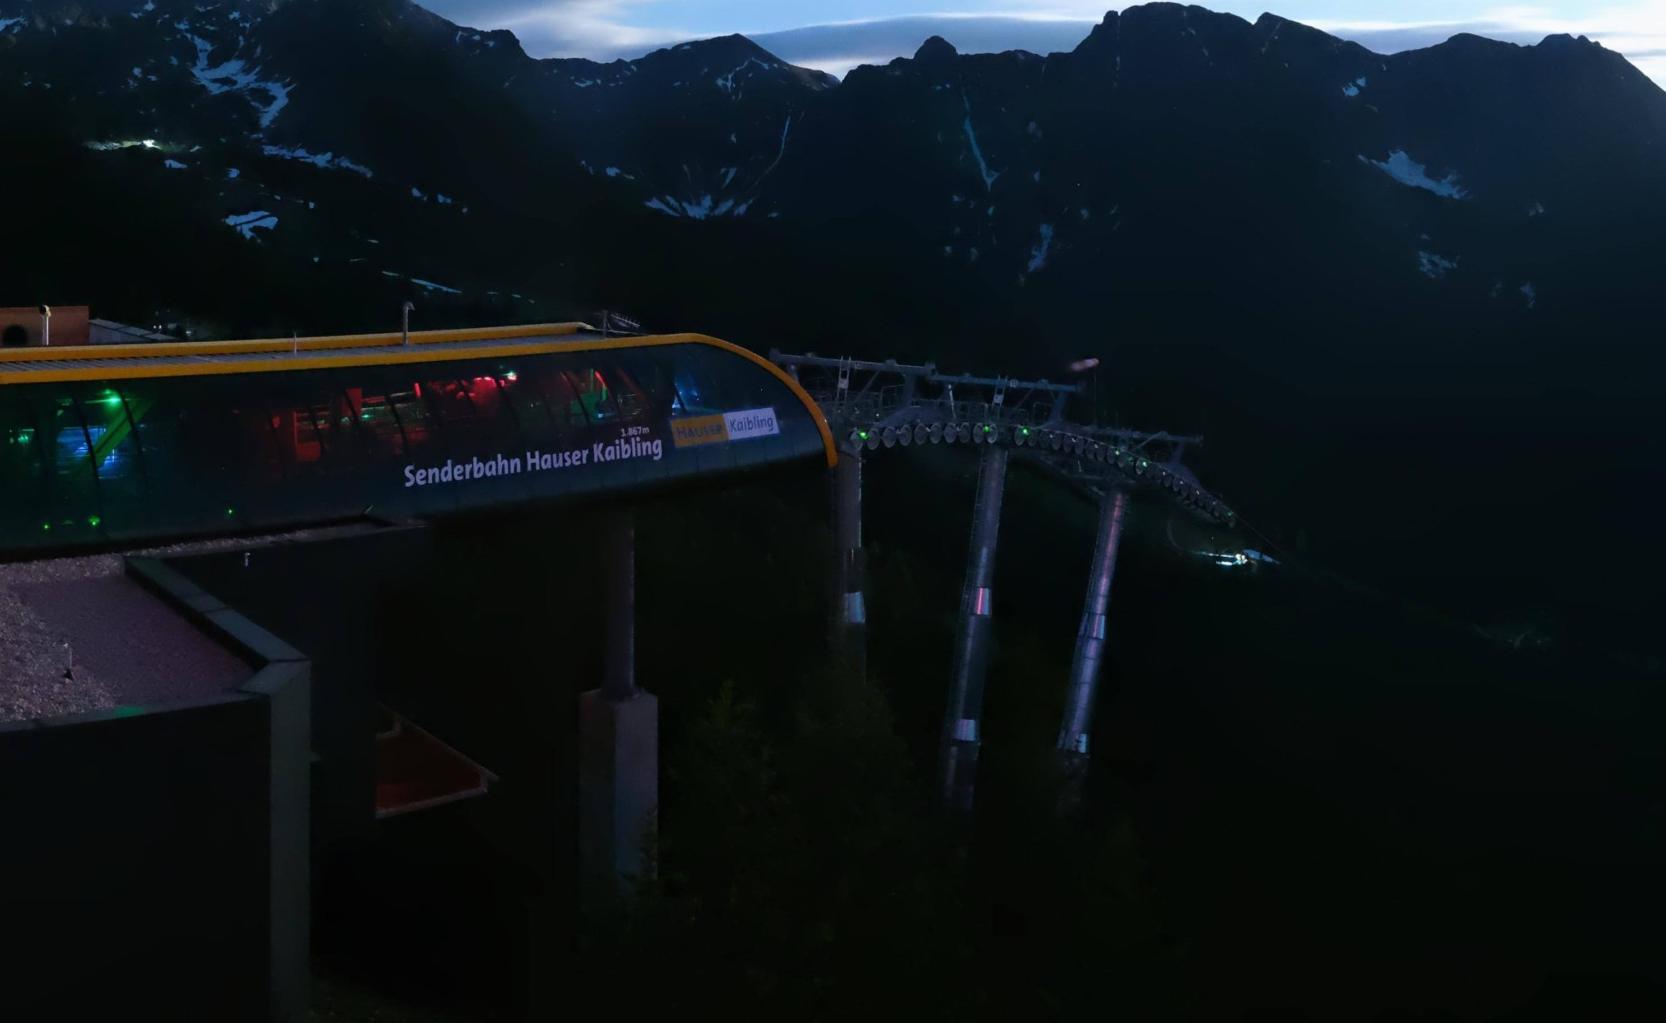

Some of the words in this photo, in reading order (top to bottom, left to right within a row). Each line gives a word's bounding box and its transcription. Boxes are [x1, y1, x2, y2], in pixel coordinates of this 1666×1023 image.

[676, 423, 723, 439] HAUSER
[729, 416, 775, 433] Kaibling
[403, 453, 521, 487] Senderbahn
[527, 447, 589, 472] Hauser
[593, 437, 663, 462] Kaibling
